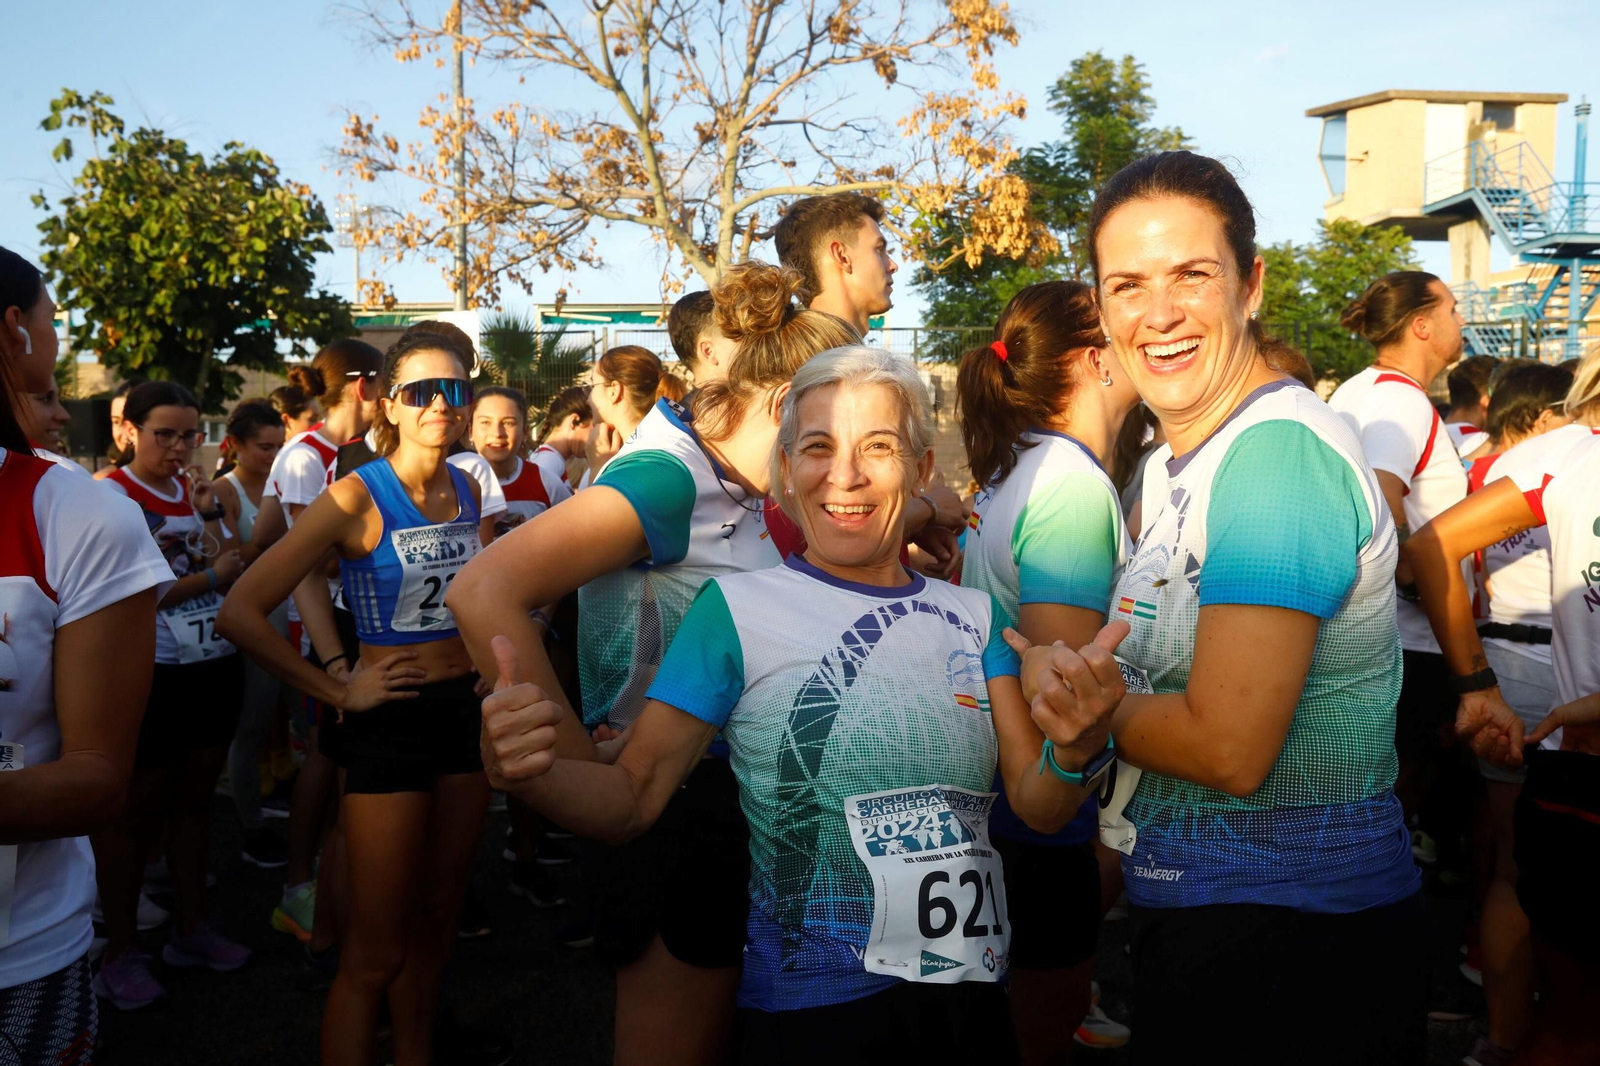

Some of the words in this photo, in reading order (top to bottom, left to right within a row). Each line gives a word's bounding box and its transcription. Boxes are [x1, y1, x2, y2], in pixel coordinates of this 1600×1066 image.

[857, 790, 931, 810] CIRCUITO
[858, 796, 947, 819] CARRERAS
[861, 812, 944, 841] 2024
[915, 854, 945, 864] CARRERA
[944, 852, 954, 860] DE
[954, 850, 963, 858] LA
[918, 869, 1003, 939] 621
